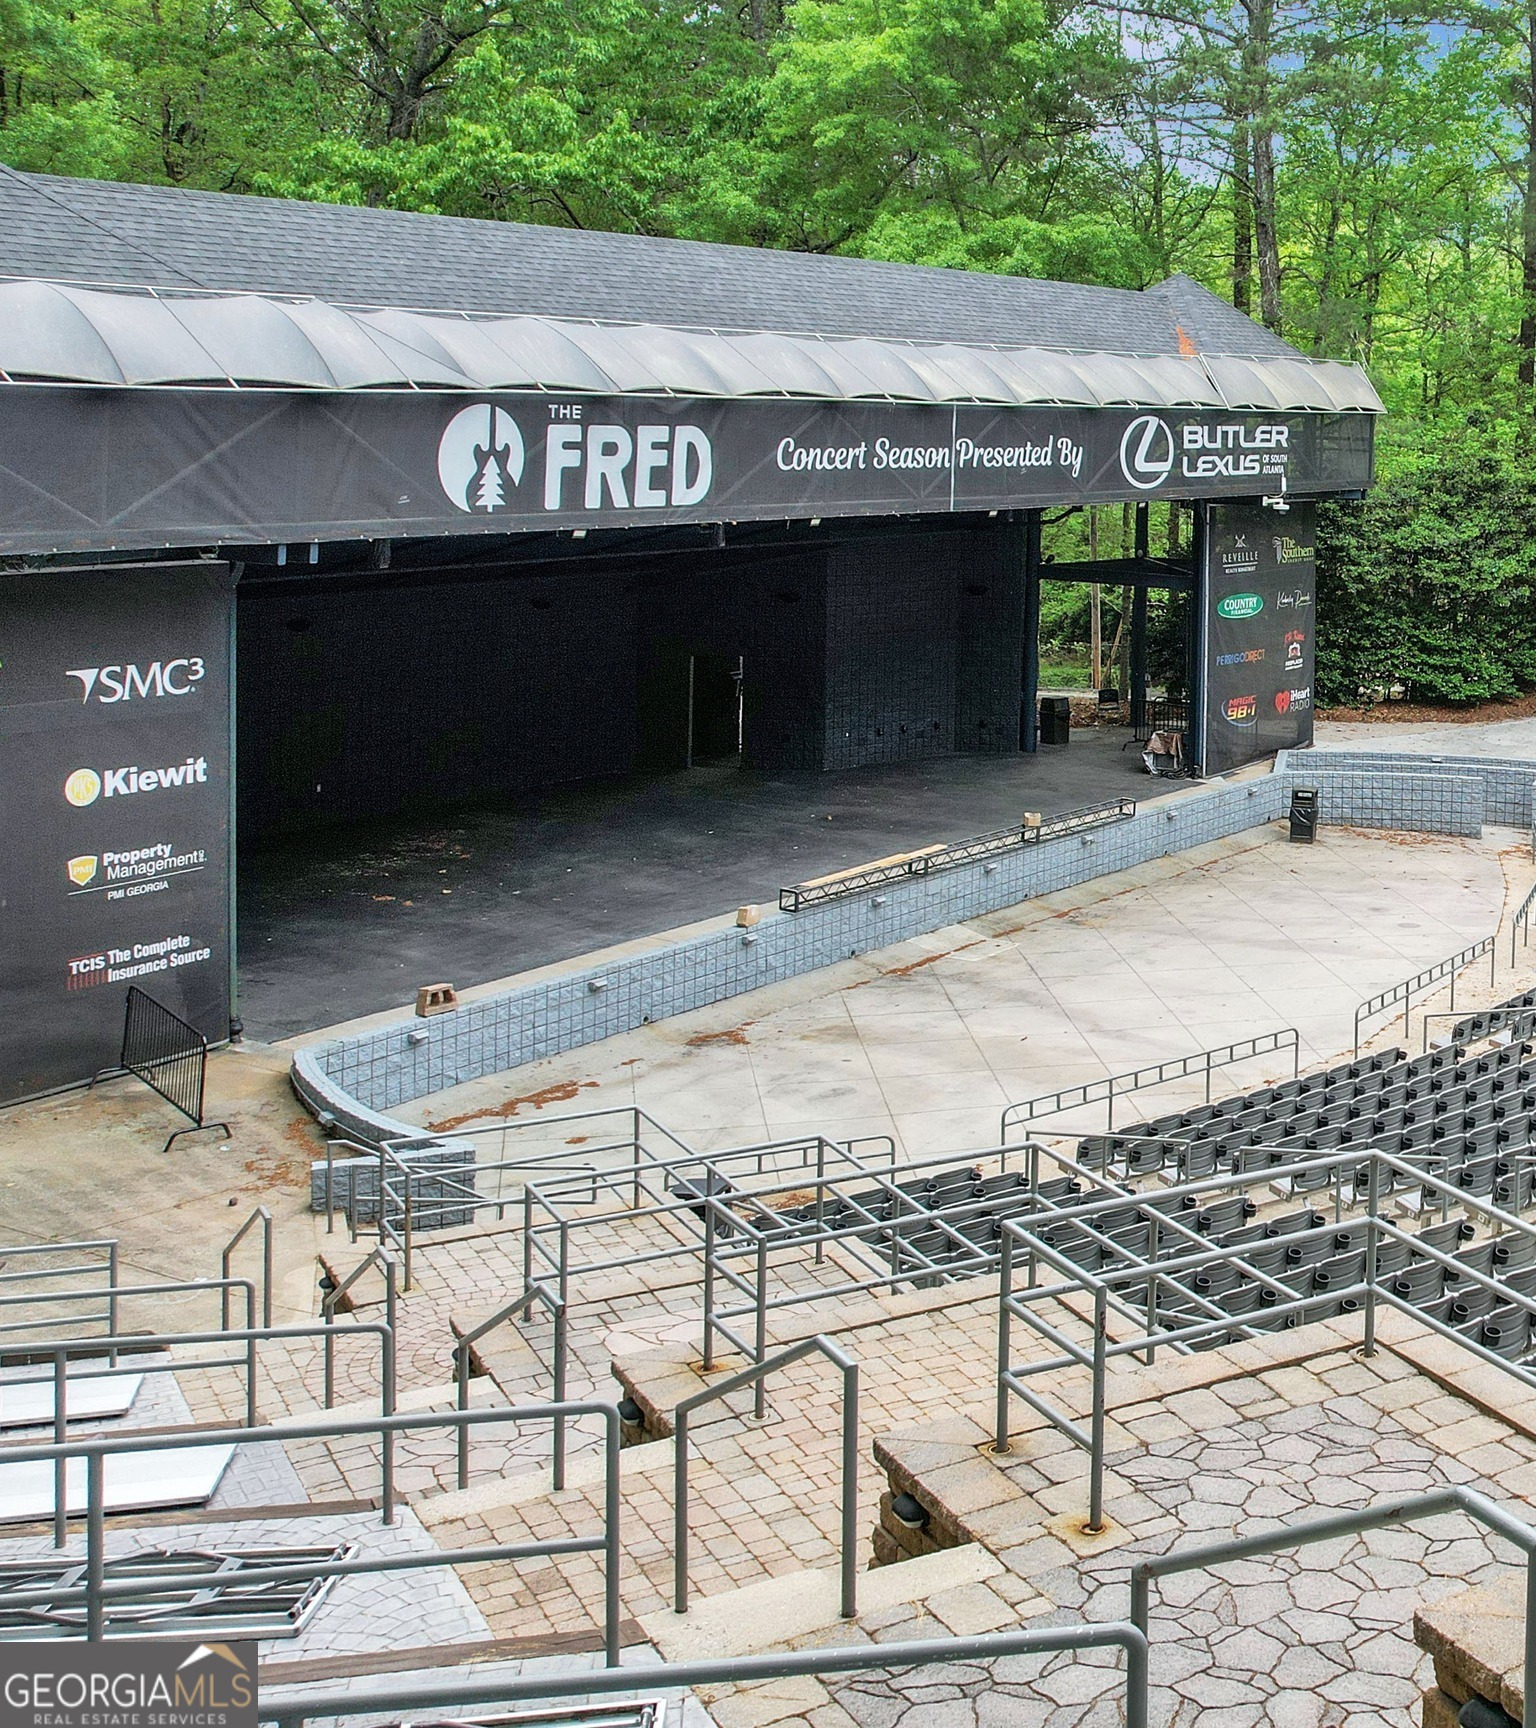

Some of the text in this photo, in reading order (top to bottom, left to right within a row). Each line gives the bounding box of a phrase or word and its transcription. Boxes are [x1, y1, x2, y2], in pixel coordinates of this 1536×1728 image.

[548, 404, 582, 419] THE
[1183, 425, 1289, 449] BUTLER
[776, 435, 1083, 477] Concert Season Presented By
[1262, 454, 1288, 463] OF SOUTH
[544, 424, 712, 510] FRED
[1182, 454, 1260, 477] LEXUS
[1262, 464, 1284, 474] ATLANTA
[1282, 537, 1296, 548] The
[1222, 551, 1258, 563] REVEILLE
[1282, 546, 1314, 563] Southern
[1224, 597, 1257, 610] COUNTRY
[1229, 695, 1256, 707] MAGIC
[1290, 687, 1310, 701] iHeart
[1290, 699, 1310, 712] RADIO
[104, 756, 207, 797] Kiewit
[103, 843, 172, 866] Property
[73, 864, 93, 875] PMI
[107, 850, 198, 880] Management
[108, 881, 169, 900] PMI GEORGIA
[107, 935, 191, 964] The Complete
[68, 956, 106, 975] TCIS
[108, 947, 211, 982] Insurance Source
